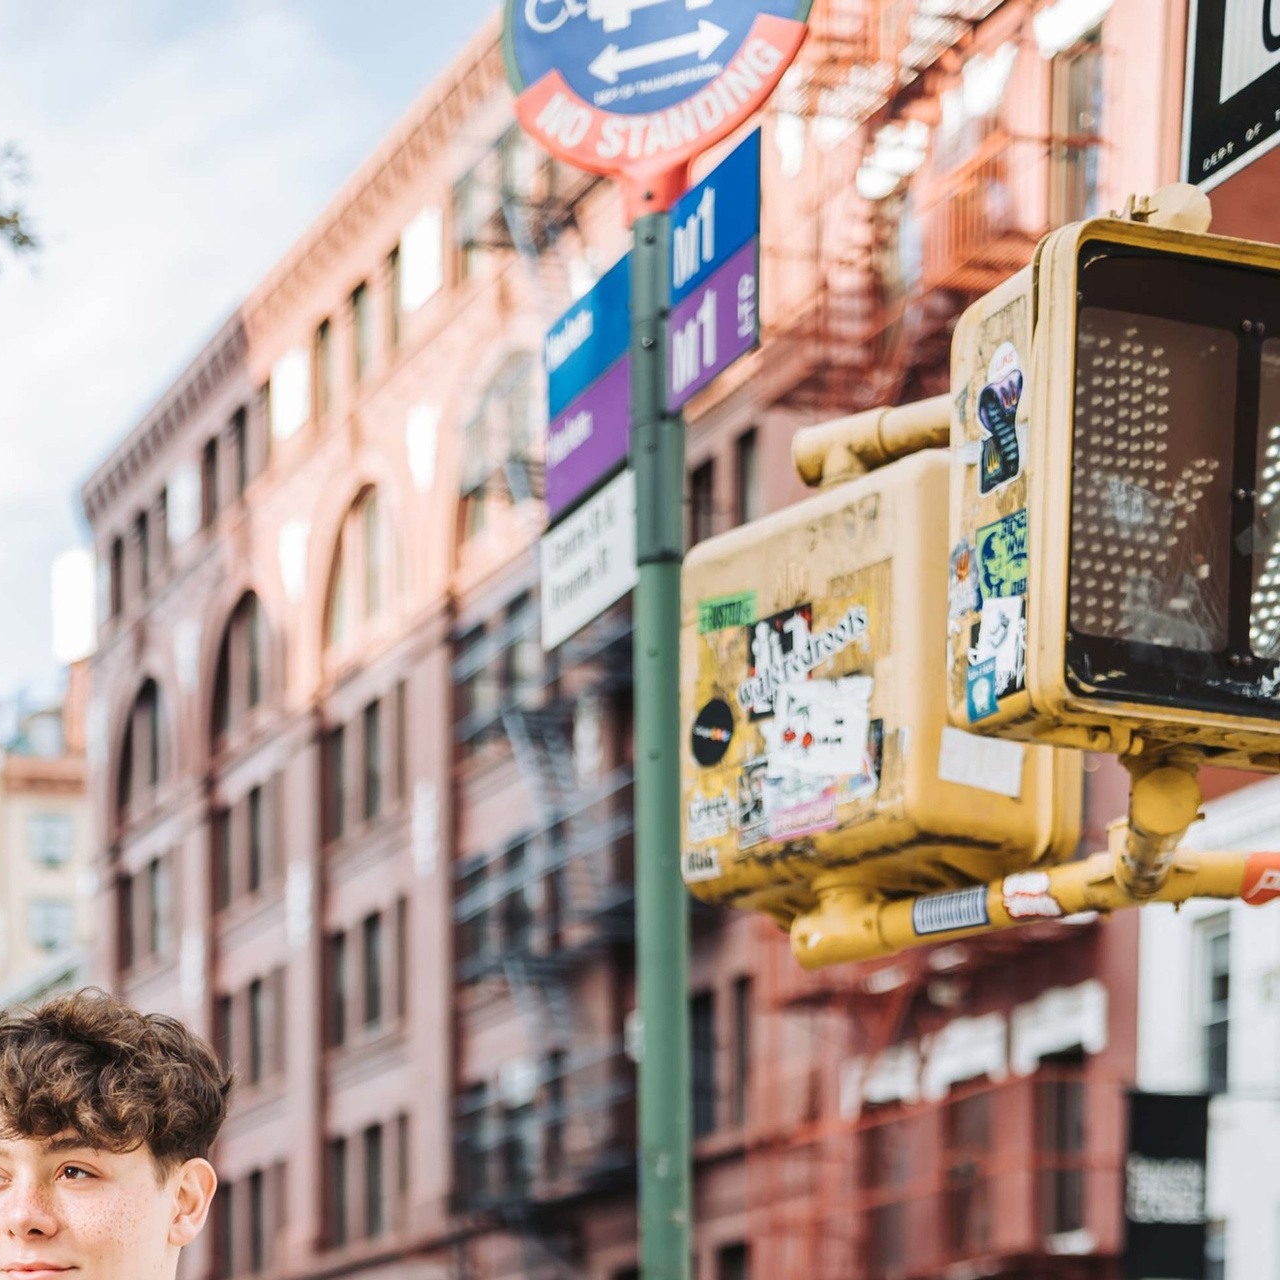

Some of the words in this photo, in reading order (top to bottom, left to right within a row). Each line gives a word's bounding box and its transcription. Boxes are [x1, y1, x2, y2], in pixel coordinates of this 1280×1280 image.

[535, 92, 593, 149] NO
[596, 38, 784, 160] STANDING
[1202, 141, 1235, 172] DEPT
[1245, 122, 1263, 142] OF
[673, 185, 716, 289] M1
[672, 287, 718, 395] M1
